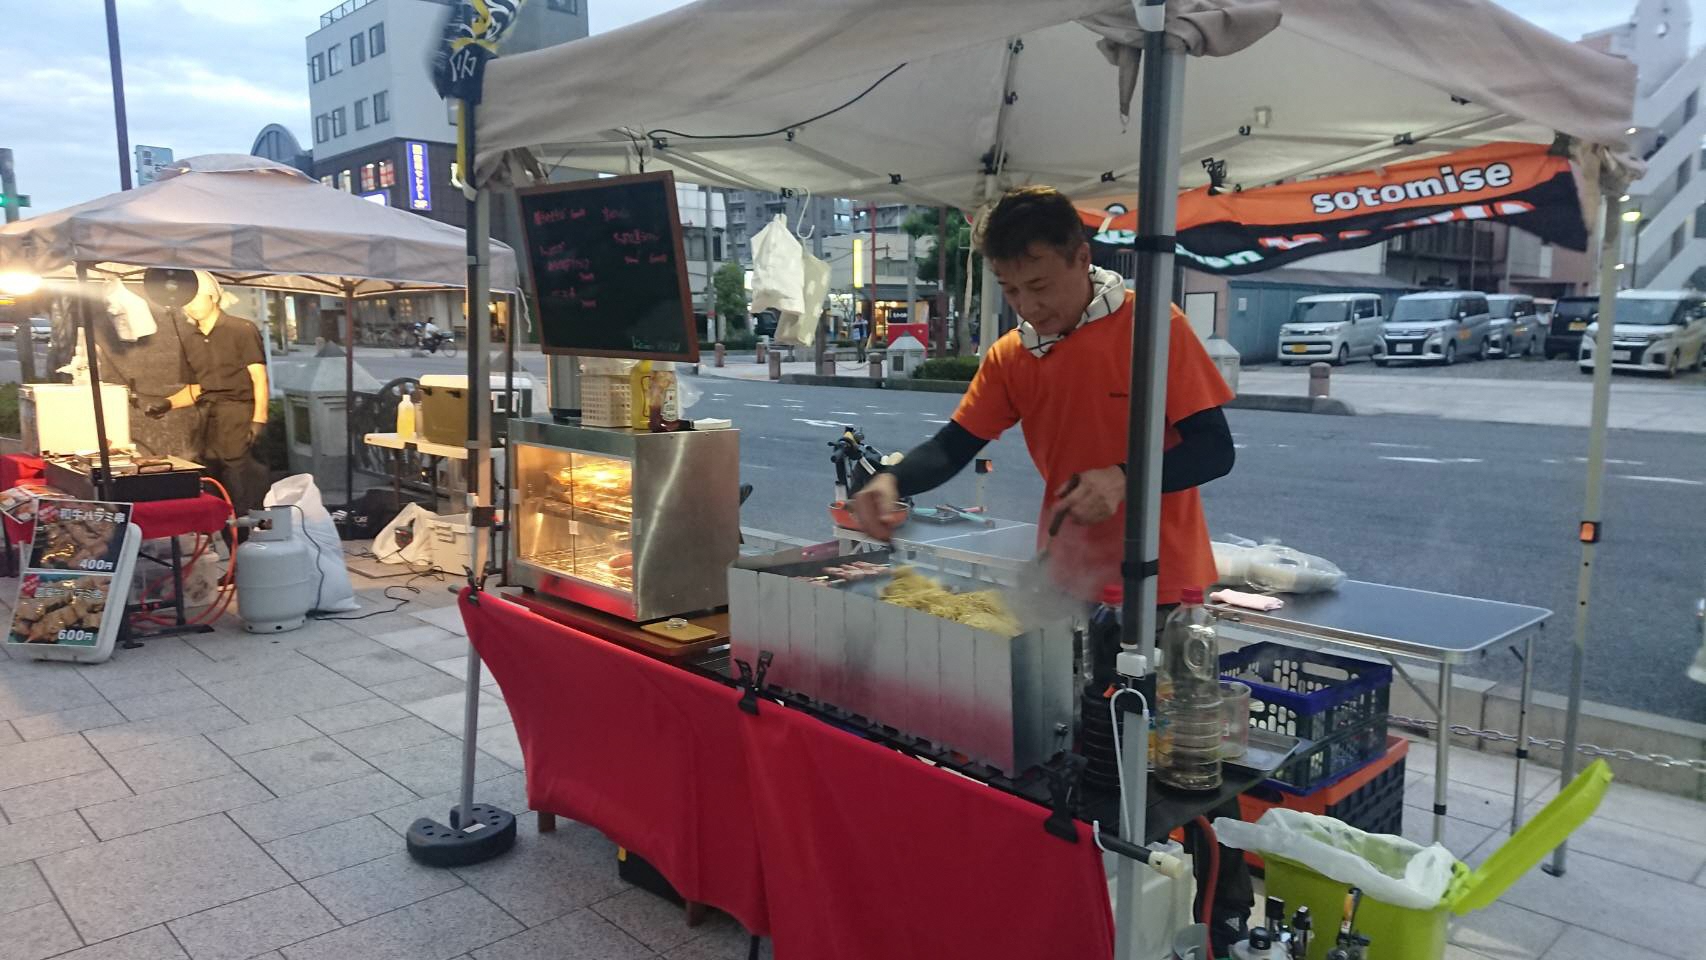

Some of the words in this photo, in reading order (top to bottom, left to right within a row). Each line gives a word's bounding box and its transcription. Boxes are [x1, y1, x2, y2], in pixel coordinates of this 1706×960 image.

[1311, 161, 1513, 215] sotomise
[79, 559, 114, 570] 400円
[57, 629, 94, 641] 600円
